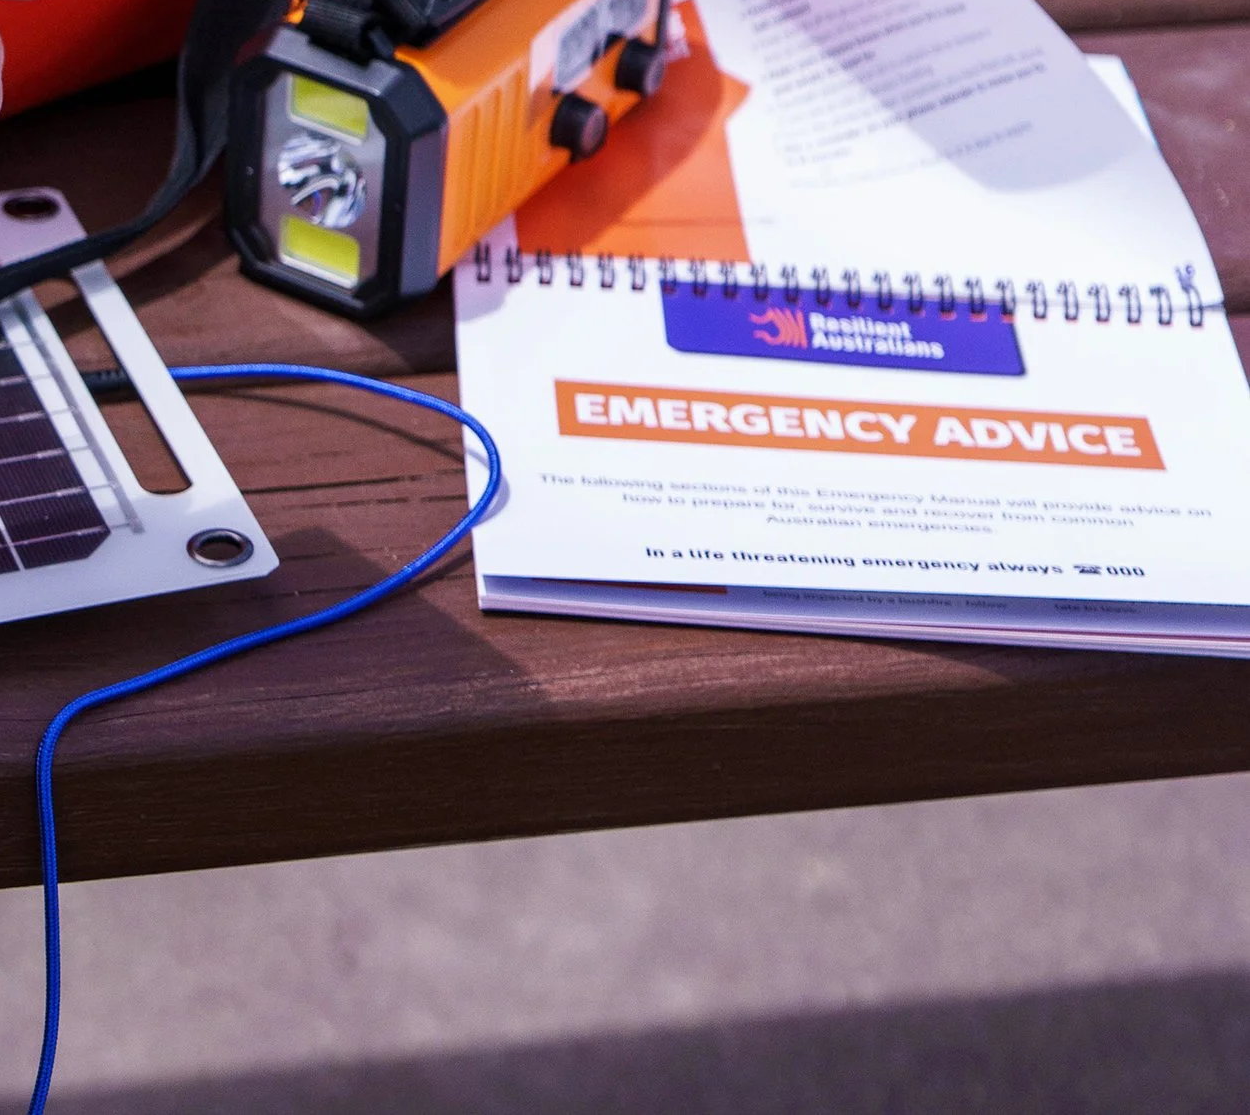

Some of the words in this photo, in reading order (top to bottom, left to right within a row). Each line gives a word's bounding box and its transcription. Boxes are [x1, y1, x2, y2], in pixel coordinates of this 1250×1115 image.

[809, 311, 912, 340] Resilient
[811, 330, 945, 360] Australians
[574, 392, 917, 444] EMERGENCY
[933, 414, 1143, 458] ADVICE
[540, 472, 575, 484] The
[580, 474, 664, 491] following
[669, 480, 748, 493] sections
[752, 485, 772, 495] of
[776, 485, 811, 497] this
[816, 488, 924, 503] Emergency
[930, 493, 1002, 507] Manual
[1005, 498, 1038, 508] will
[1043, 500, 1113, 512] provide
[1119, 503, 1182, 516] advice
[1186, 507, 1213, 518] on
[621, 492, 663, 505] how
[667, 495, 686, 505] to
[691, 497, 766, 510] prepare
[807, 501, 875, 514] survive
[881, 506, 918, 516] and
[923, 508, 995, 519] recover
[1001, 510, 1046, 522] from
[1050, 515, 1136, 527] common
[765, 513, 863, 528] Australian
[645, 546, 666, 559] In
[672, 549, 684, 559] a
[688, 547, 725, 560] life
[731, 550, 856, 567] threatening
[861, 555, 981, 572] emergency
[986, 560, 1064, 575] always
[1105, 564, 1146, 578] 000
